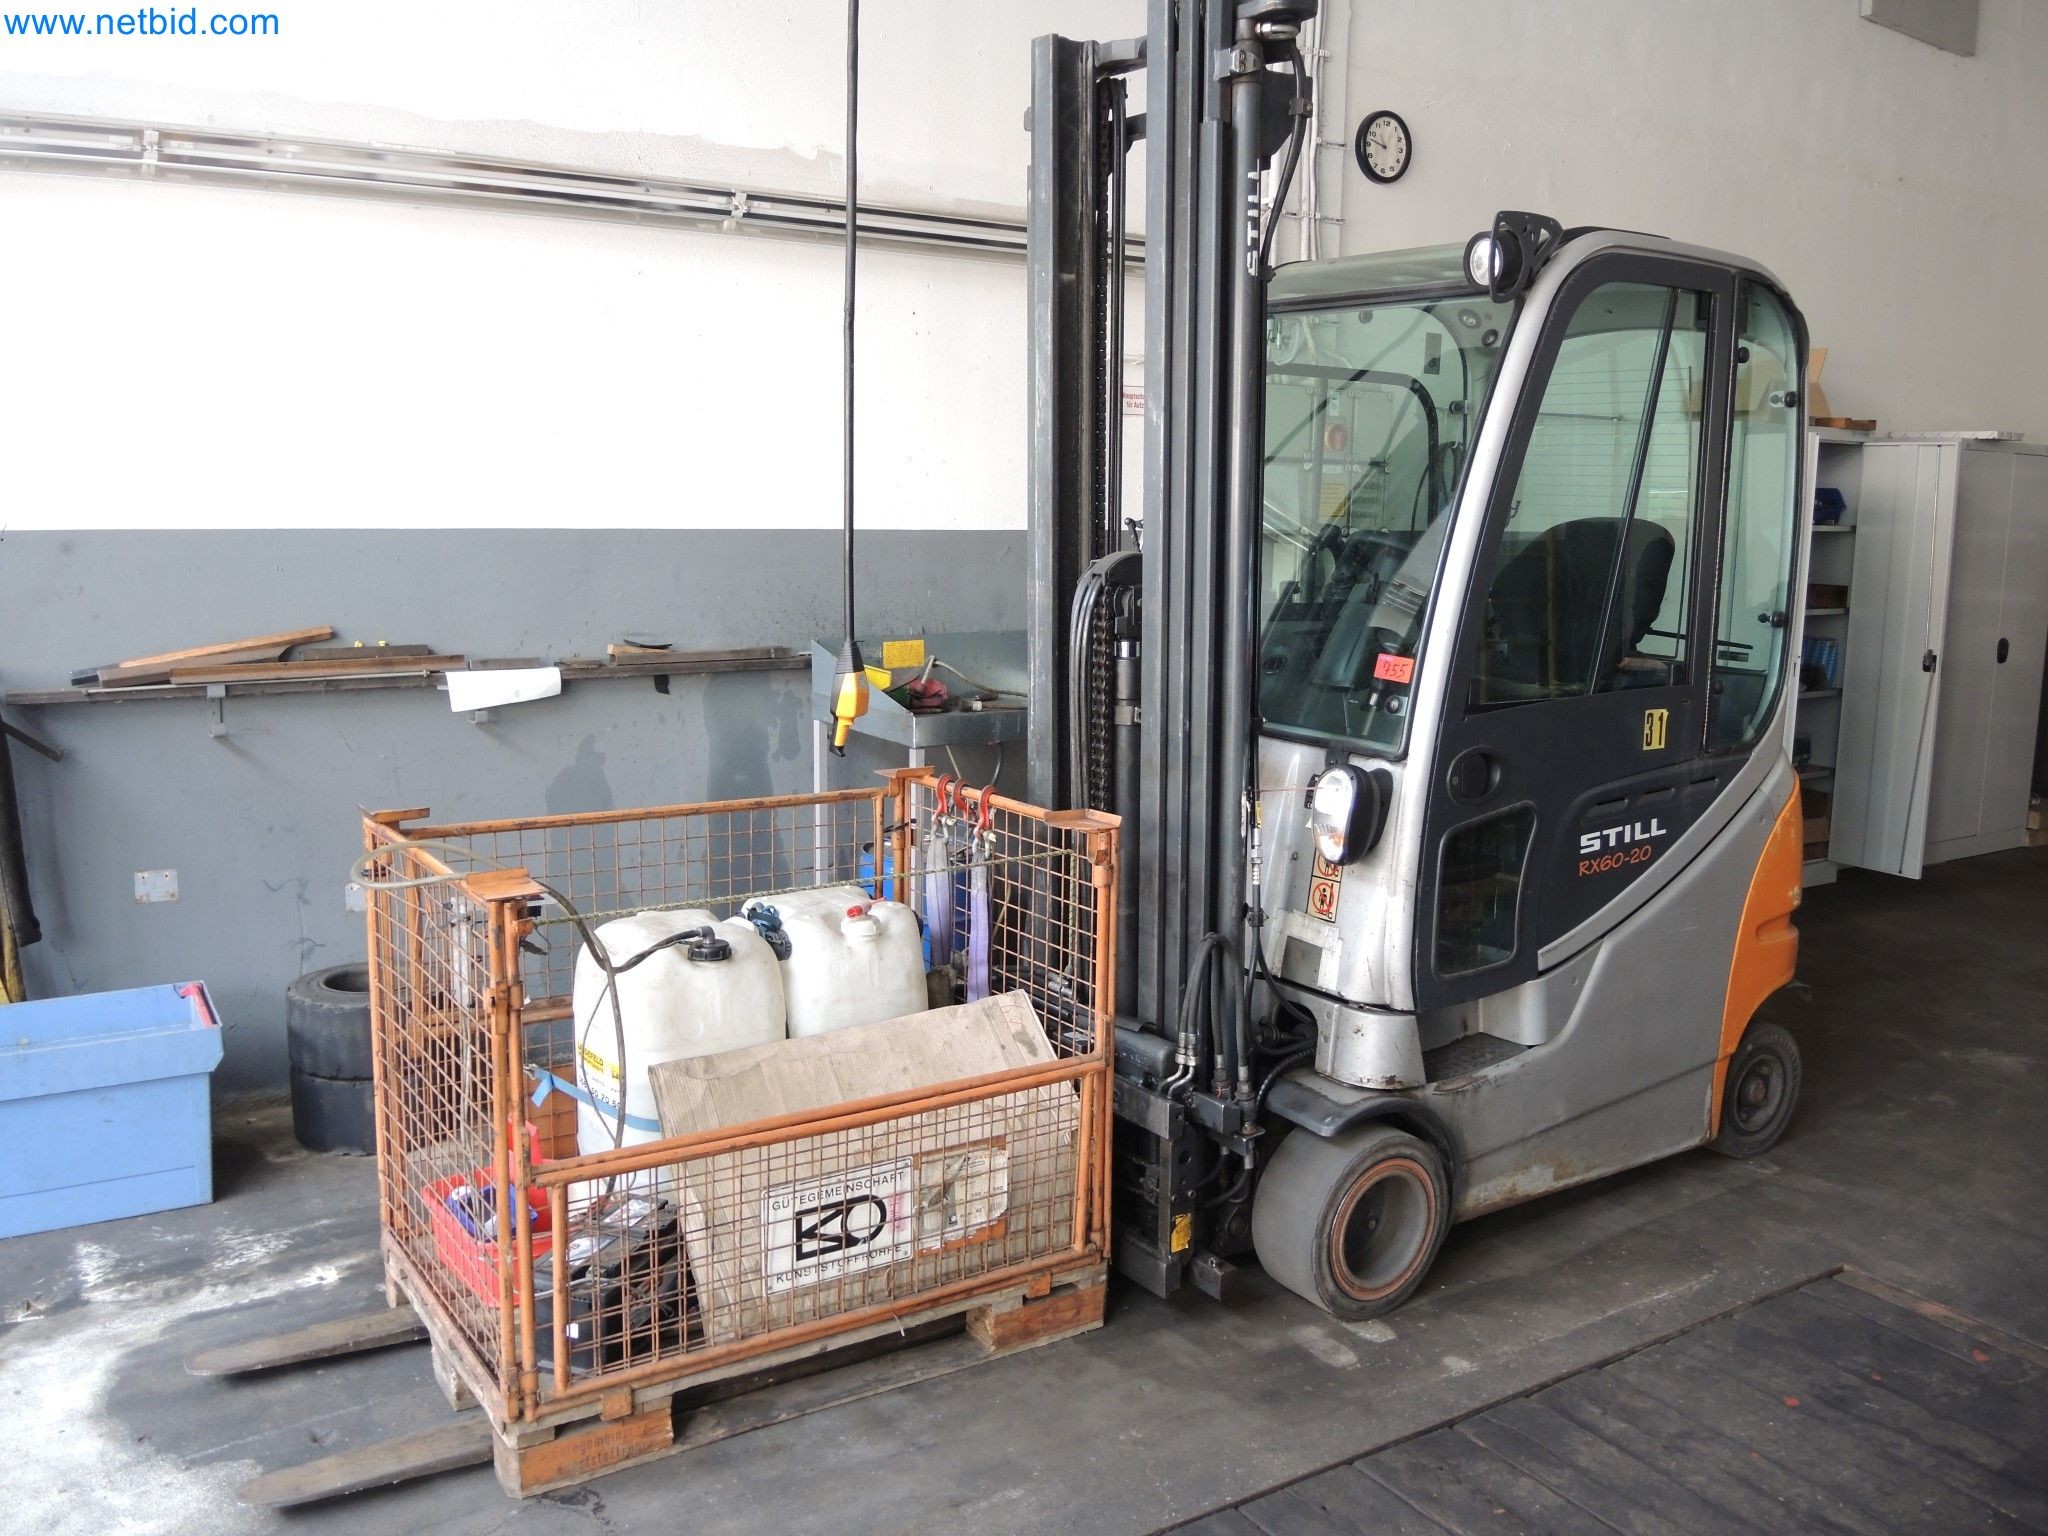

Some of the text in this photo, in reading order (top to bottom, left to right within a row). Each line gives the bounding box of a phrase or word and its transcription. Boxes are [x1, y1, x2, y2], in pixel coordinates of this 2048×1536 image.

[1246, 160, 1260, 276] STILL
[1645, 712, 1664, 747] 31
[1579, 817, 1667, 855] STILL
[1578, 845, 1652, 877] RX60-20
